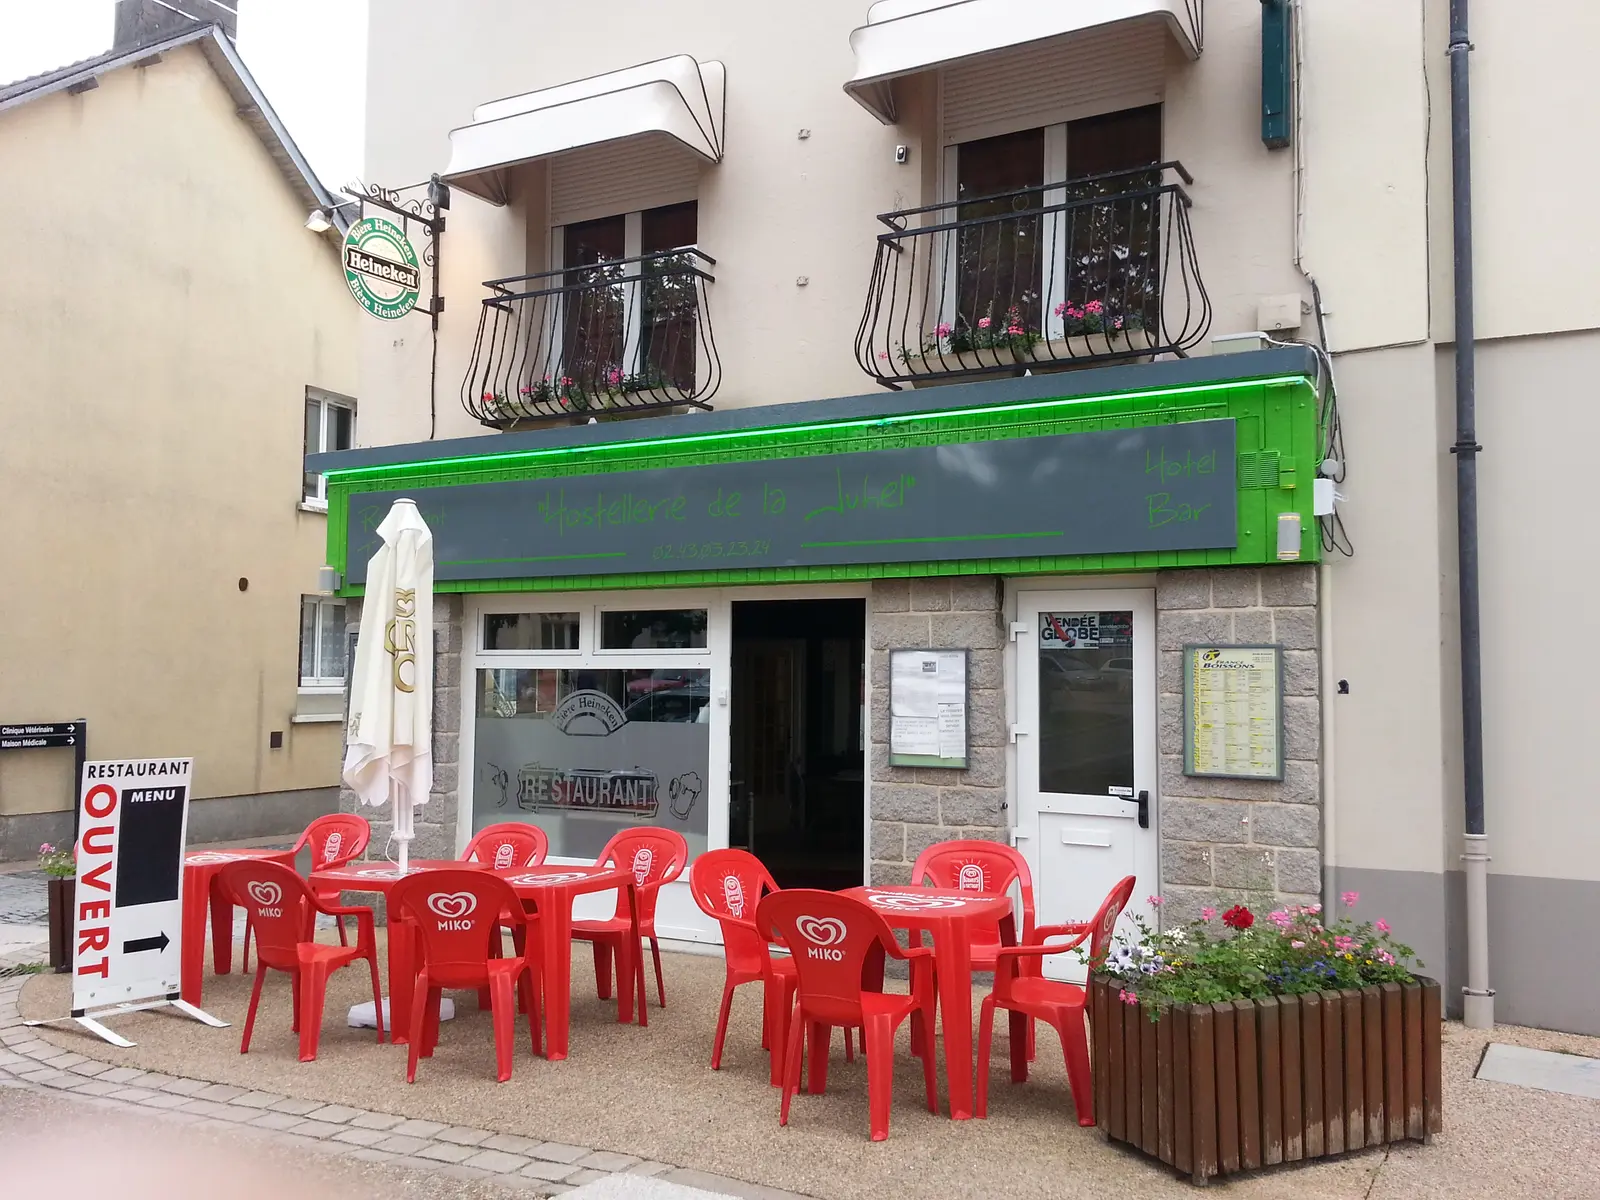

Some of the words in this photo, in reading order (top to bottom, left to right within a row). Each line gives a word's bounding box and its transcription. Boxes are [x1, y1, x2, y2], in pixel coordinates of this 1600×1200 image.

[350, 222, 373, 241] Bière
[374, 219, 414, 259] Heineken
[349, 251, 416, 287] Heineken
[350, 278, 371, 307] Bière
[373, 297, 415, 318] Heineken
[1145, 446, 1217, 484] Hotel
[708, 487, 742, 517] de
[763, 482, 787, 515] la
[1145, 492, 1212, 529] Bar
[1045, 614, 1096, 627] VENDÉE
[1041, 627, 1100, 641] GLOBE
[579, 696, 618, 728] Heineken
[2, 726, 25, 736] Clinique
[25, 725, 54, 734] Vétérinaire
[2, 740, 22, 748] Maison
[22, 738, 47, 747] Médicale
[87, 761, 190, 779] RESTAURANT
[131, 789, 176, 803] MENU
[524, 775, 649, 806] RESTAURANT
[77, 783, 118, 979] OUVERT
[257, 907, 281, 918] MIKO
[437, 919, 472, 931] MIKO
[807, 946, 843, 962] MIKO
